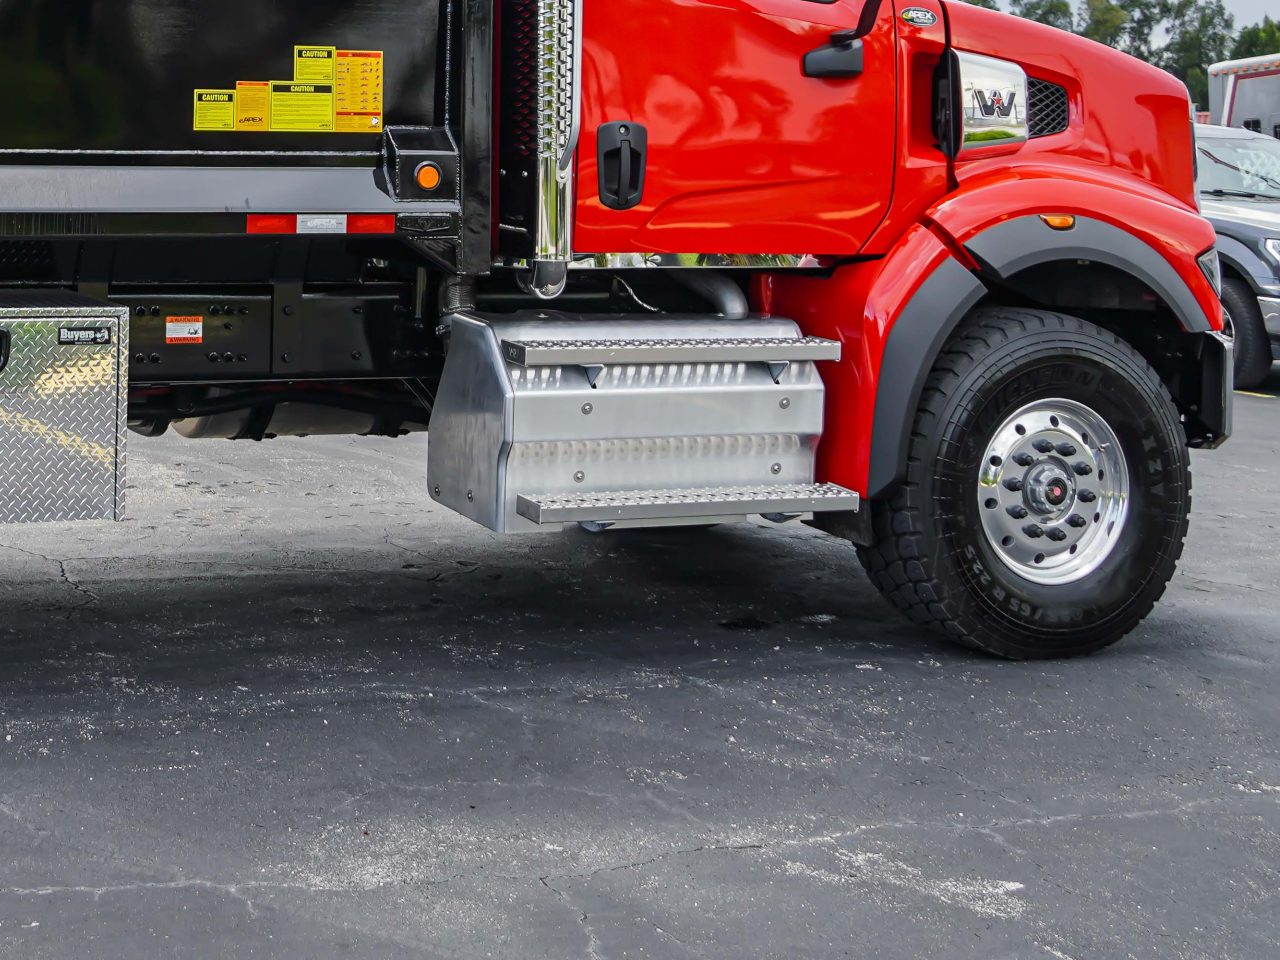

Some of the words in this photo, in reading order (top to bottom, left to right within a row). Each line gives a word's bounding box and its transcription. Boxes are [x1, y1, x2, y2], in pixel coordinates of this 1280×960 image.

[302, 50, 328, 58] CAUTION
[290, 85, 315, 93] CAUTION
[60, 328, 95, 341] Buyers
